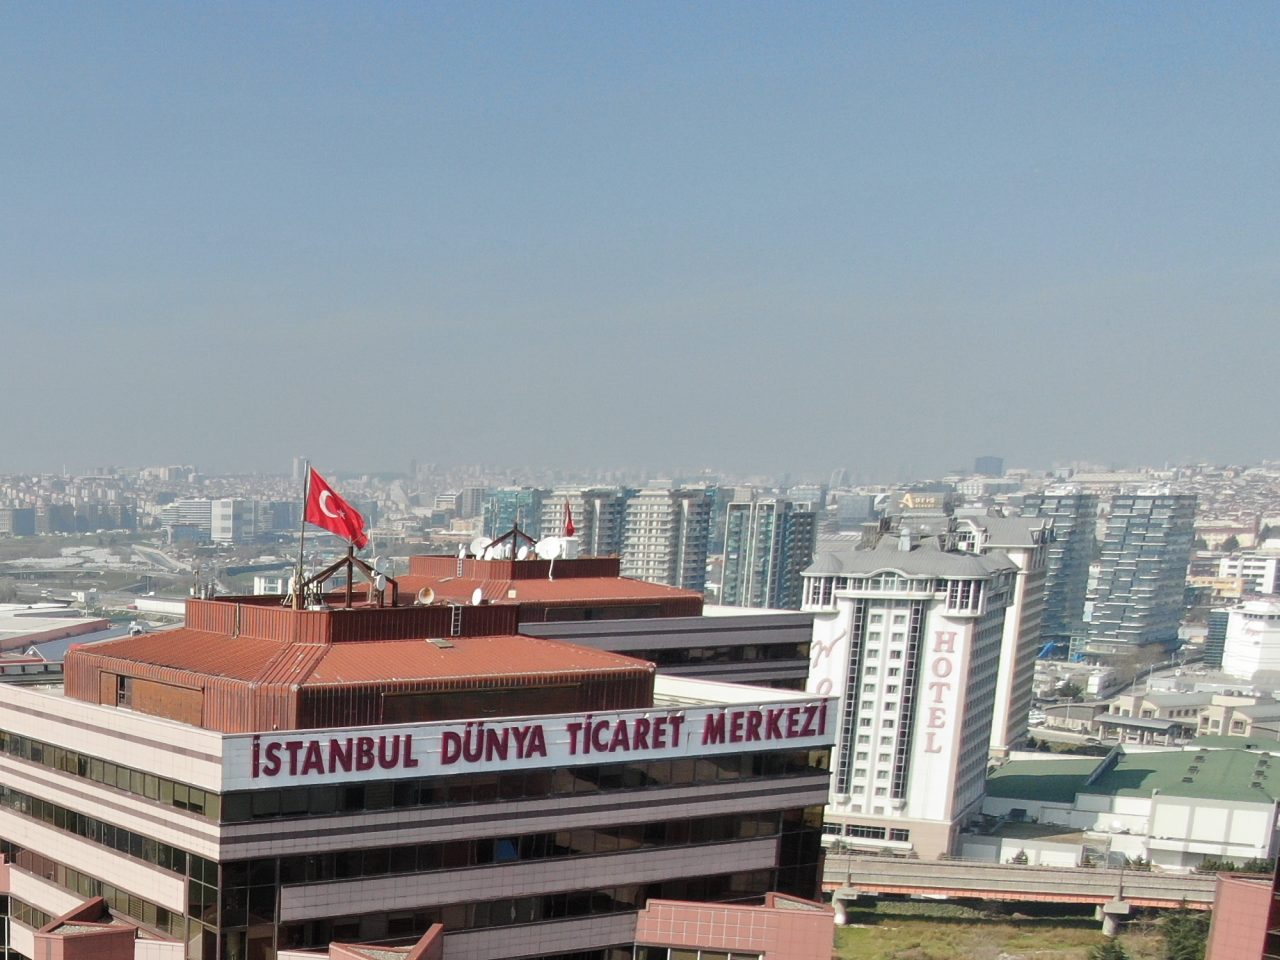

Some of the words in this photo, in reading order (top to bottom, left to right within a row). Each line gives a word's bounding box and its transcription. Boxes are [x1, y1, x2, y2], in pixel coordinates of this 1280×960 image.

[252, 734, 419, 778] İSTANBUL
[441, 721, 548, 765] DÜNYA
[566, 714, 685, 755] TİCARET
[701, 698, 828, 745] MERKEZİ
[924, 630, 958, 754] HOTEL
